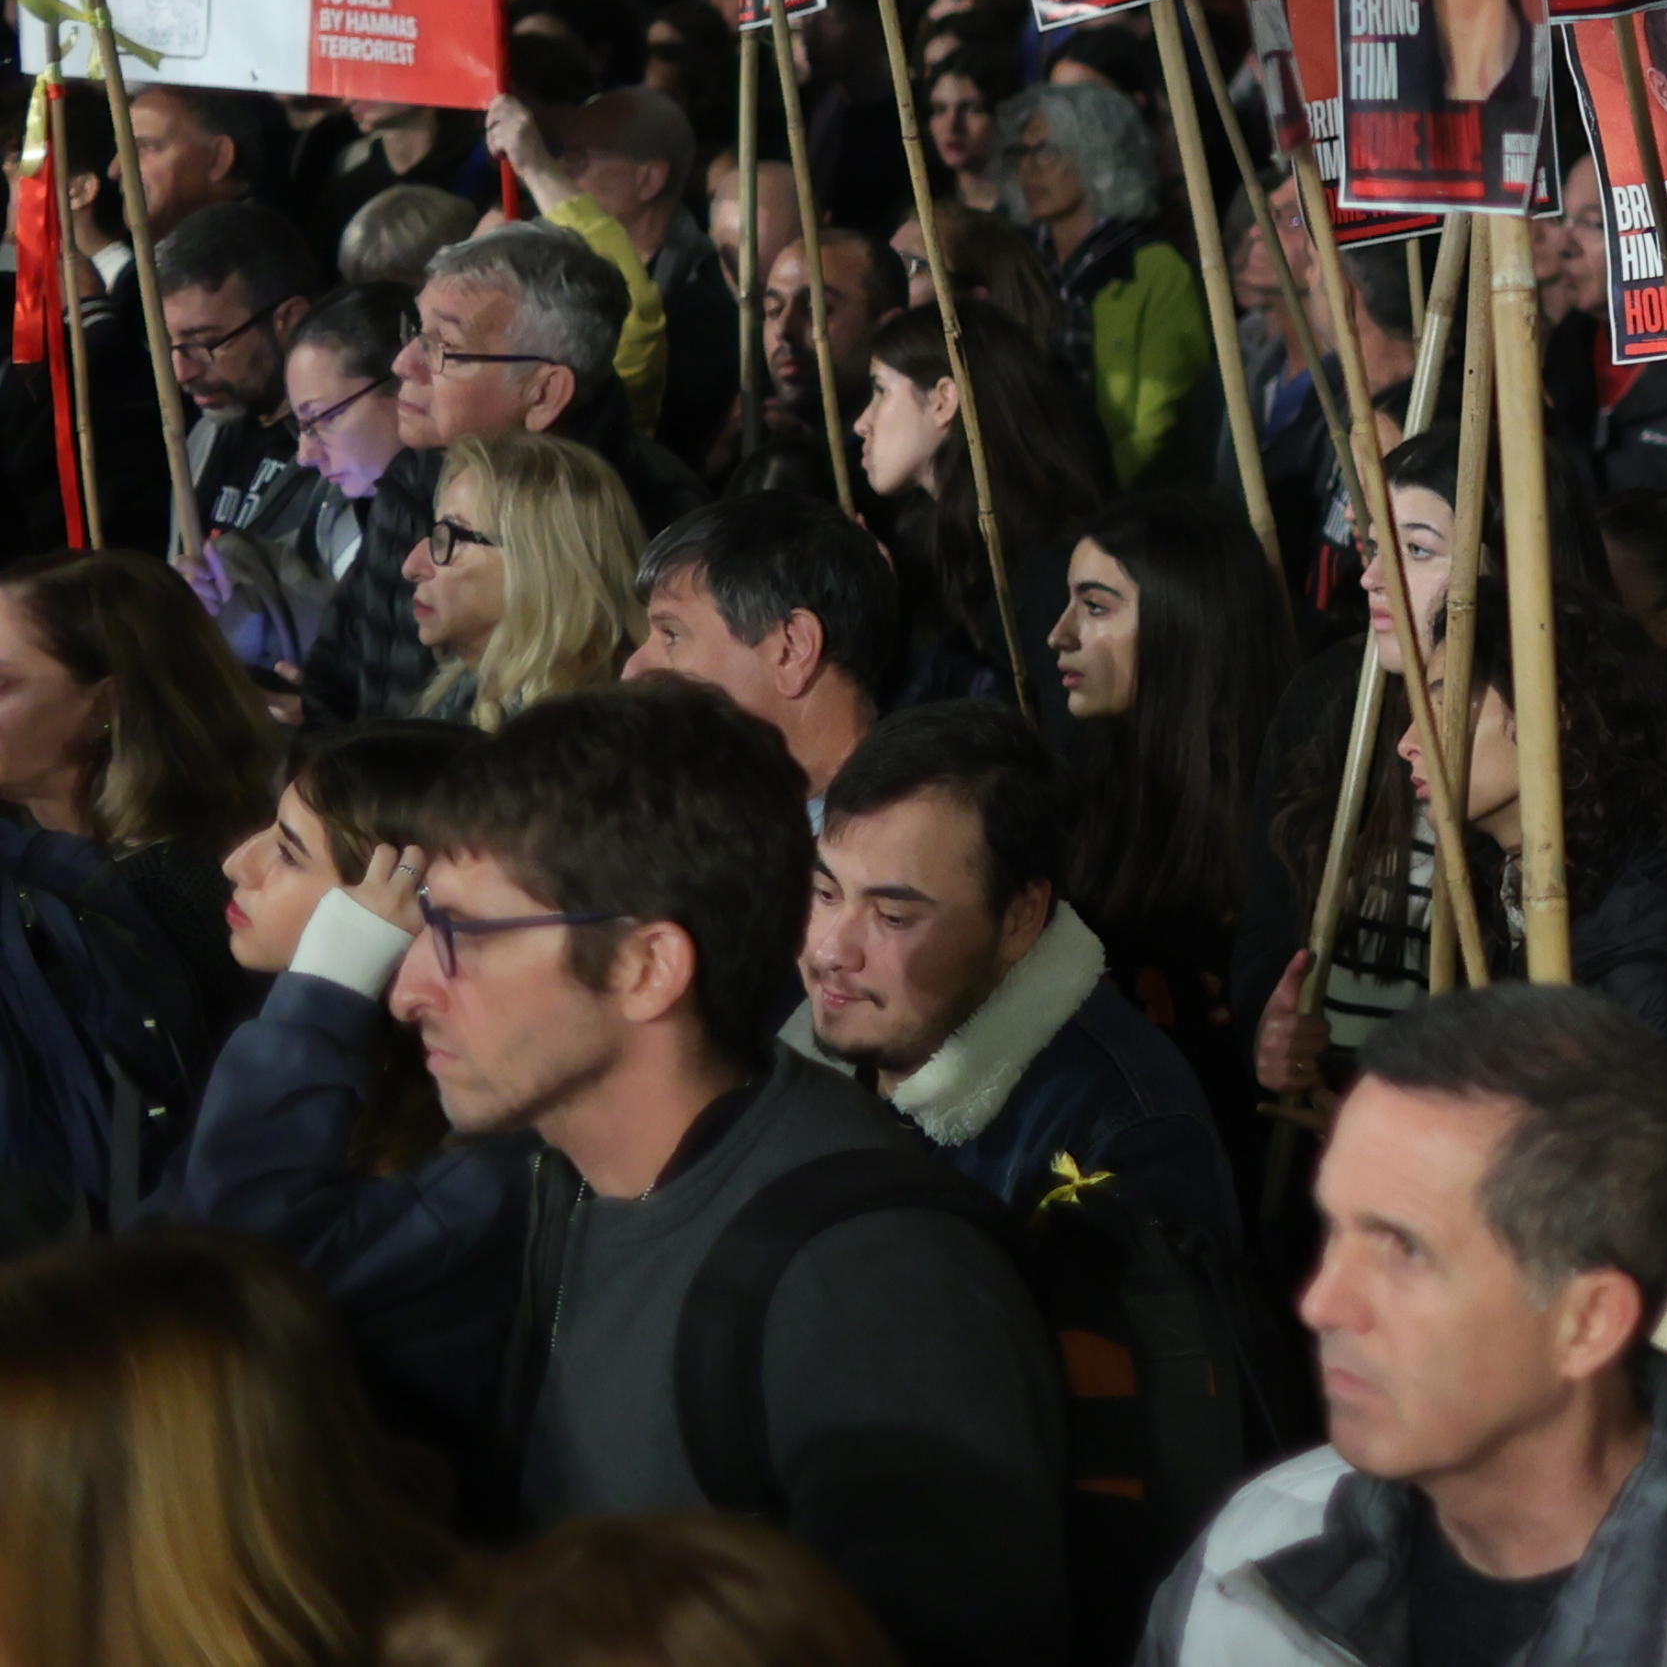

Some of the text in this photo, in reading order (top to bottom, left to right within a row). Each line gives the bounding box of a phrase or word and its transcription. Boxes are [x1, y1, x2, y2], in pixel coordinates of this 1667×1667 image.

[319, 9, 417, 39] BY HAMMAS
[319, 36, 414, 65] TERRORIEST
[1349, 42, 1398, 101] HIM
